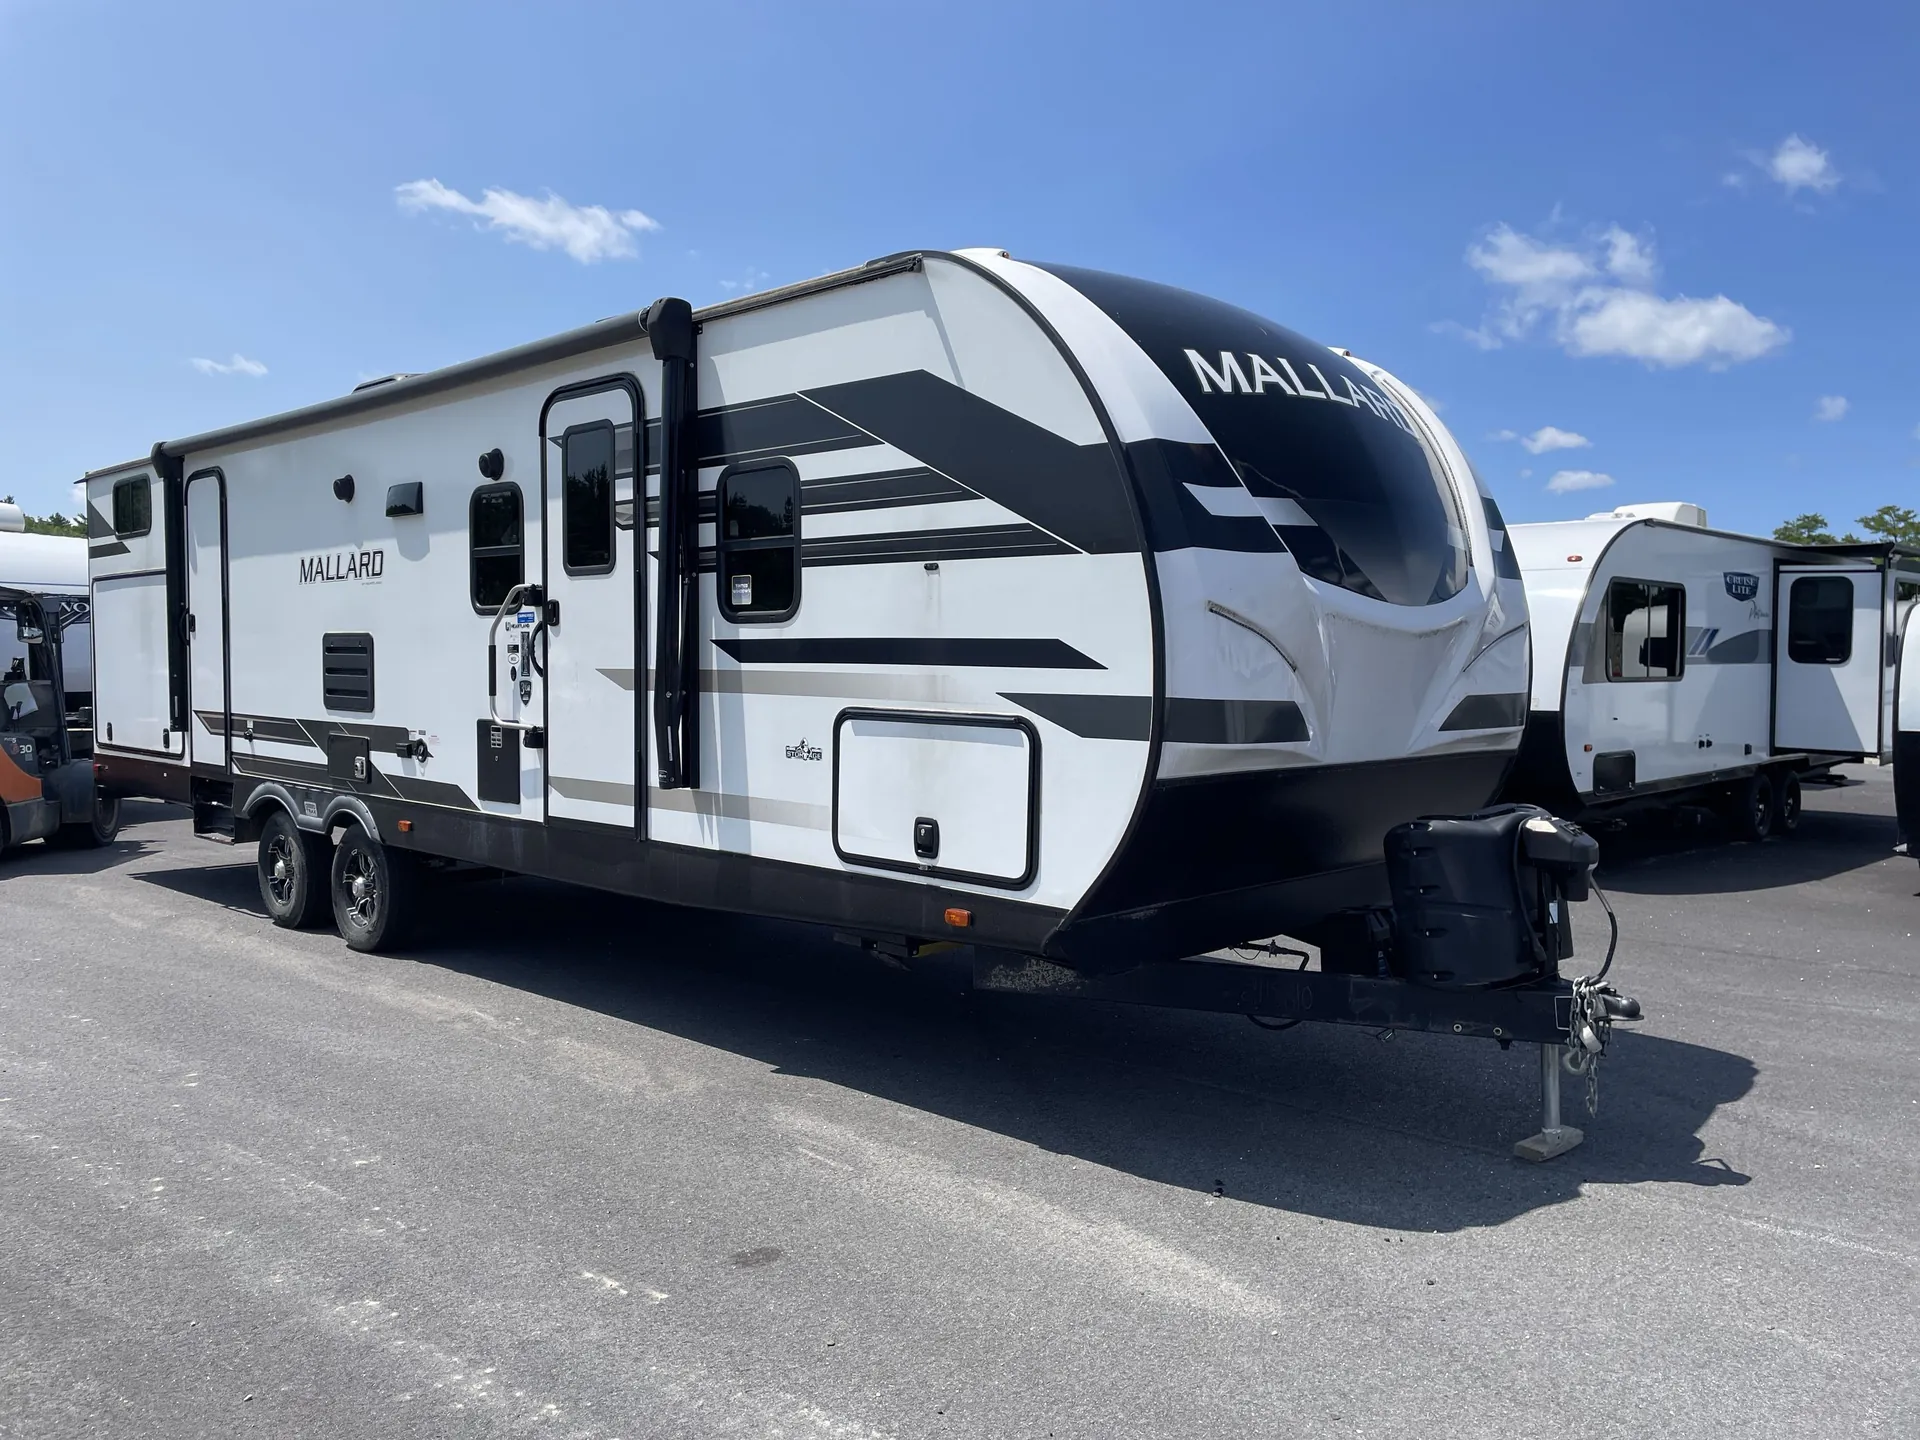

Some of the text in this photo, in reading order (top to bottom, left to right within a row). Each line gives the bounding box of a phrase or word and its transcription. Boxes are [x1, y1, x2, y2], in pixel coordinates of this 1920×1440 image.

[1183, 348, 1422, 439] MALLARD
[299, 549, 384, 585] MALLARD
[1726, 575, 1757, 587] CRUISE
[1732, 584, 1752, 595] LITE
[19, 744, 33, 754] 30
